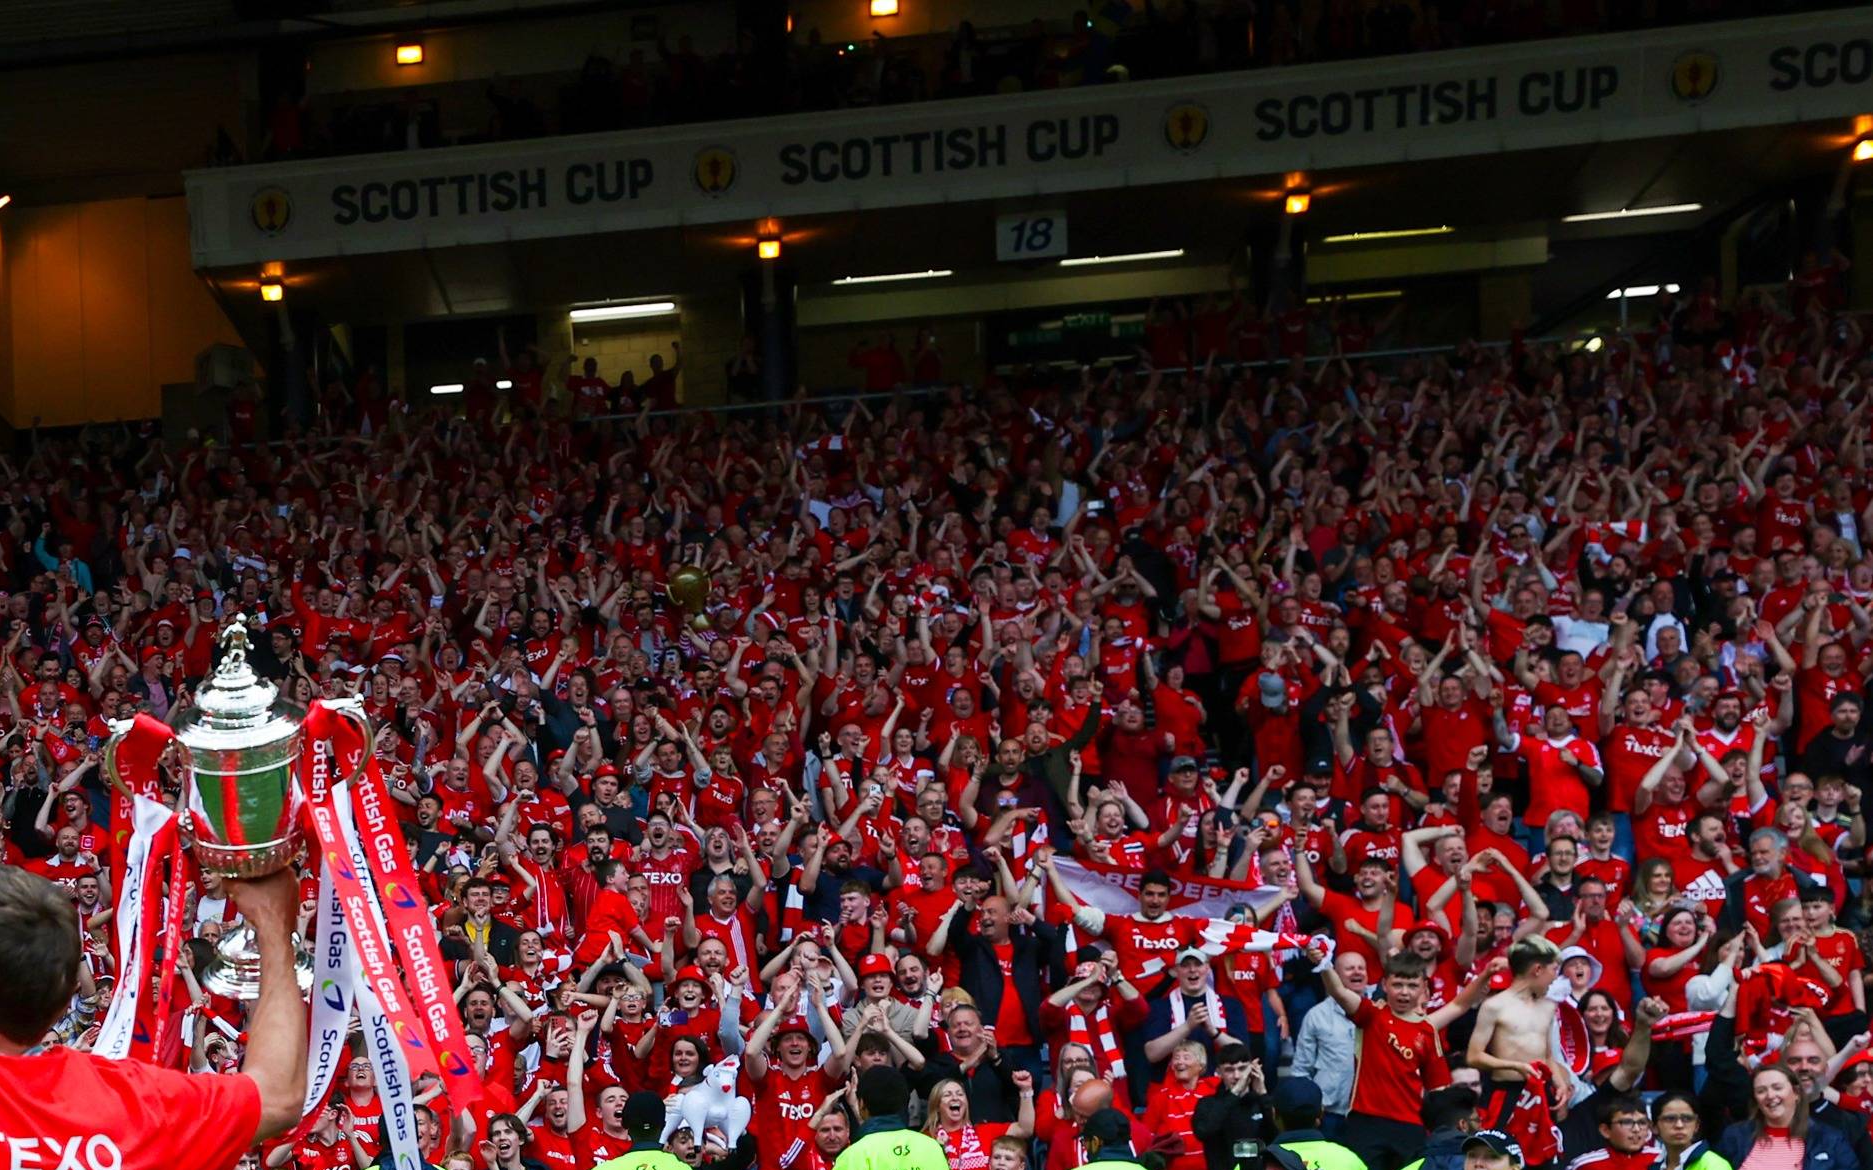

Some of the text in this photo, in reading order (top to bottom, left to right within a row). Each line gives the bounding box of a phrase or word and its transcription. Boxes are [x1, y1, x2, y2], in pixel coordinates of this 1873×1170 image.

[1255, 65, 1619, 141] SCOTTISH CUP
[780, 113, 1120, 185] SCOTTISH CUP
[333, 159, 654, 225] SCOTTISH CUP
[1011, 218, 1053, 252] 18
[527, 648, 548, 662] EXO
[312, 741, 335, 844] ottish Gas
[712, 791, 733, 804] TEXO
[346, 748, 397, 873] Sottish Gas
[1658, 822, 1687, 837] TEX
[1367, 846, 1399, 859] TEXO
[643, 873, 682, 885] TEXO
[1088, 866, 1244, 902] ABEDEEN
[1683, 888, 1726, 900] adida
[328, 930, 346, 969] Gas
[347, 895, 402, 1013] Scottish Gas
[1132, 935, 1178, 949] TEXO
[404, 924, 450, 1042] Scottish Gas
[1232, 970, 1255, 980] EXO
[372, 1014, 407, 1141] Scottish Gas
[779, 1103, 814, 1121] TEXO
